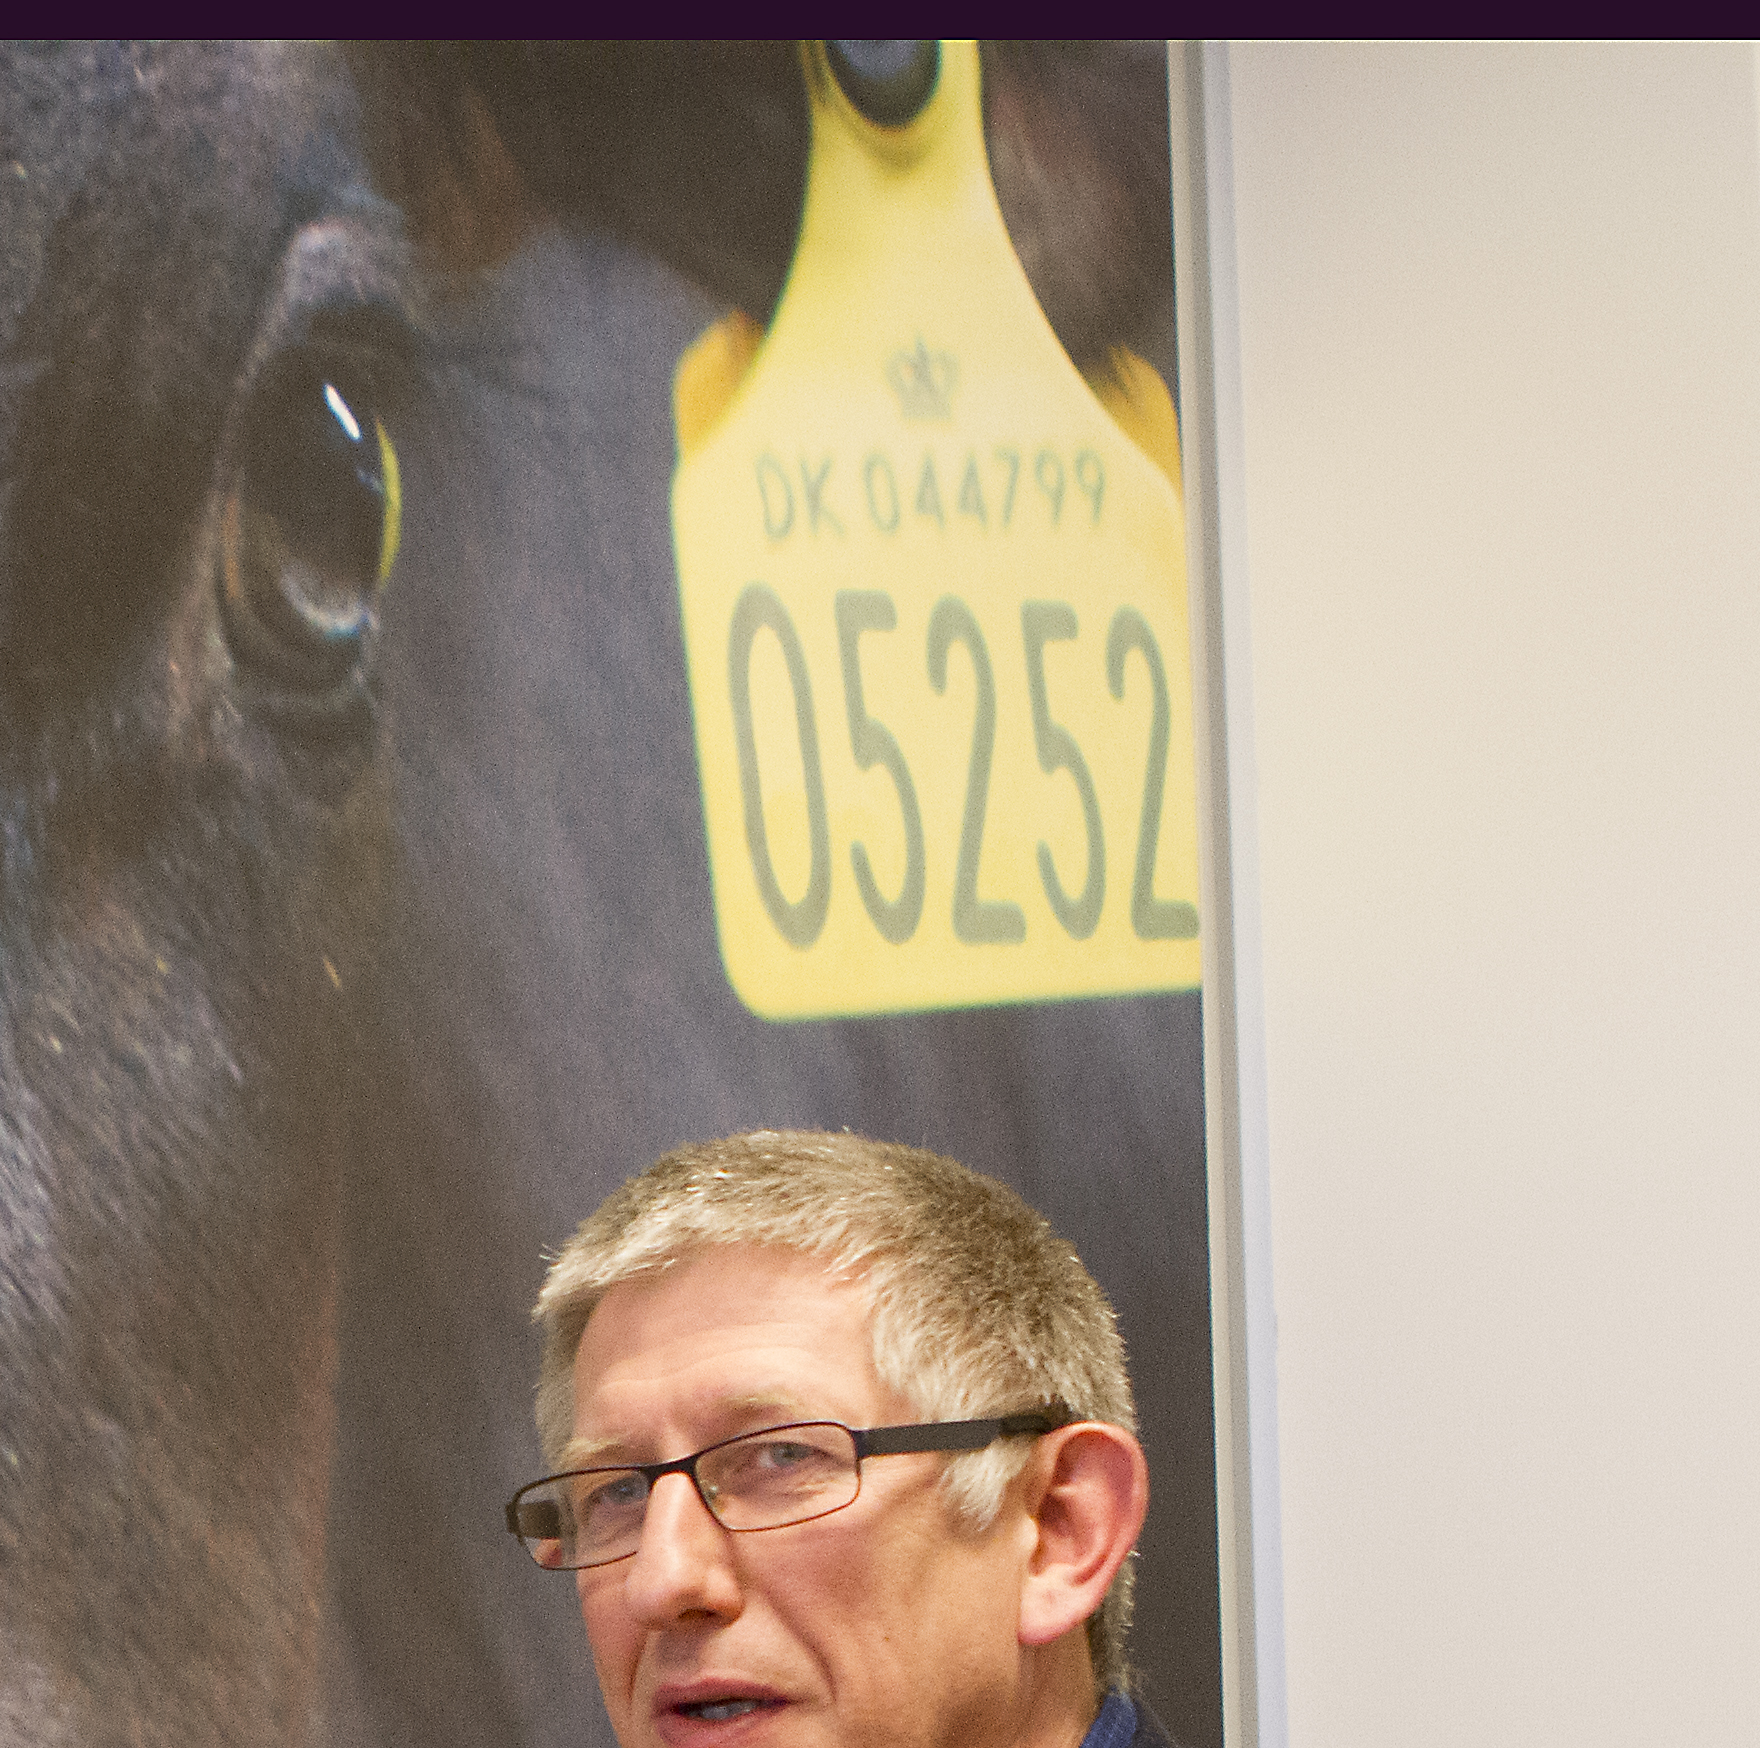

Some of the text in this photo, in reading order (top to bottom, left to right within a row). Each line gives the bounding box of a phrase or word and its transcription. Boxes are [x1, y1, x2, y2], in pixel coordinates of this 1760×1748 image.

[753, 446, 1108, 542] DK 044799
[727, 583, 1200, 952] 05252
